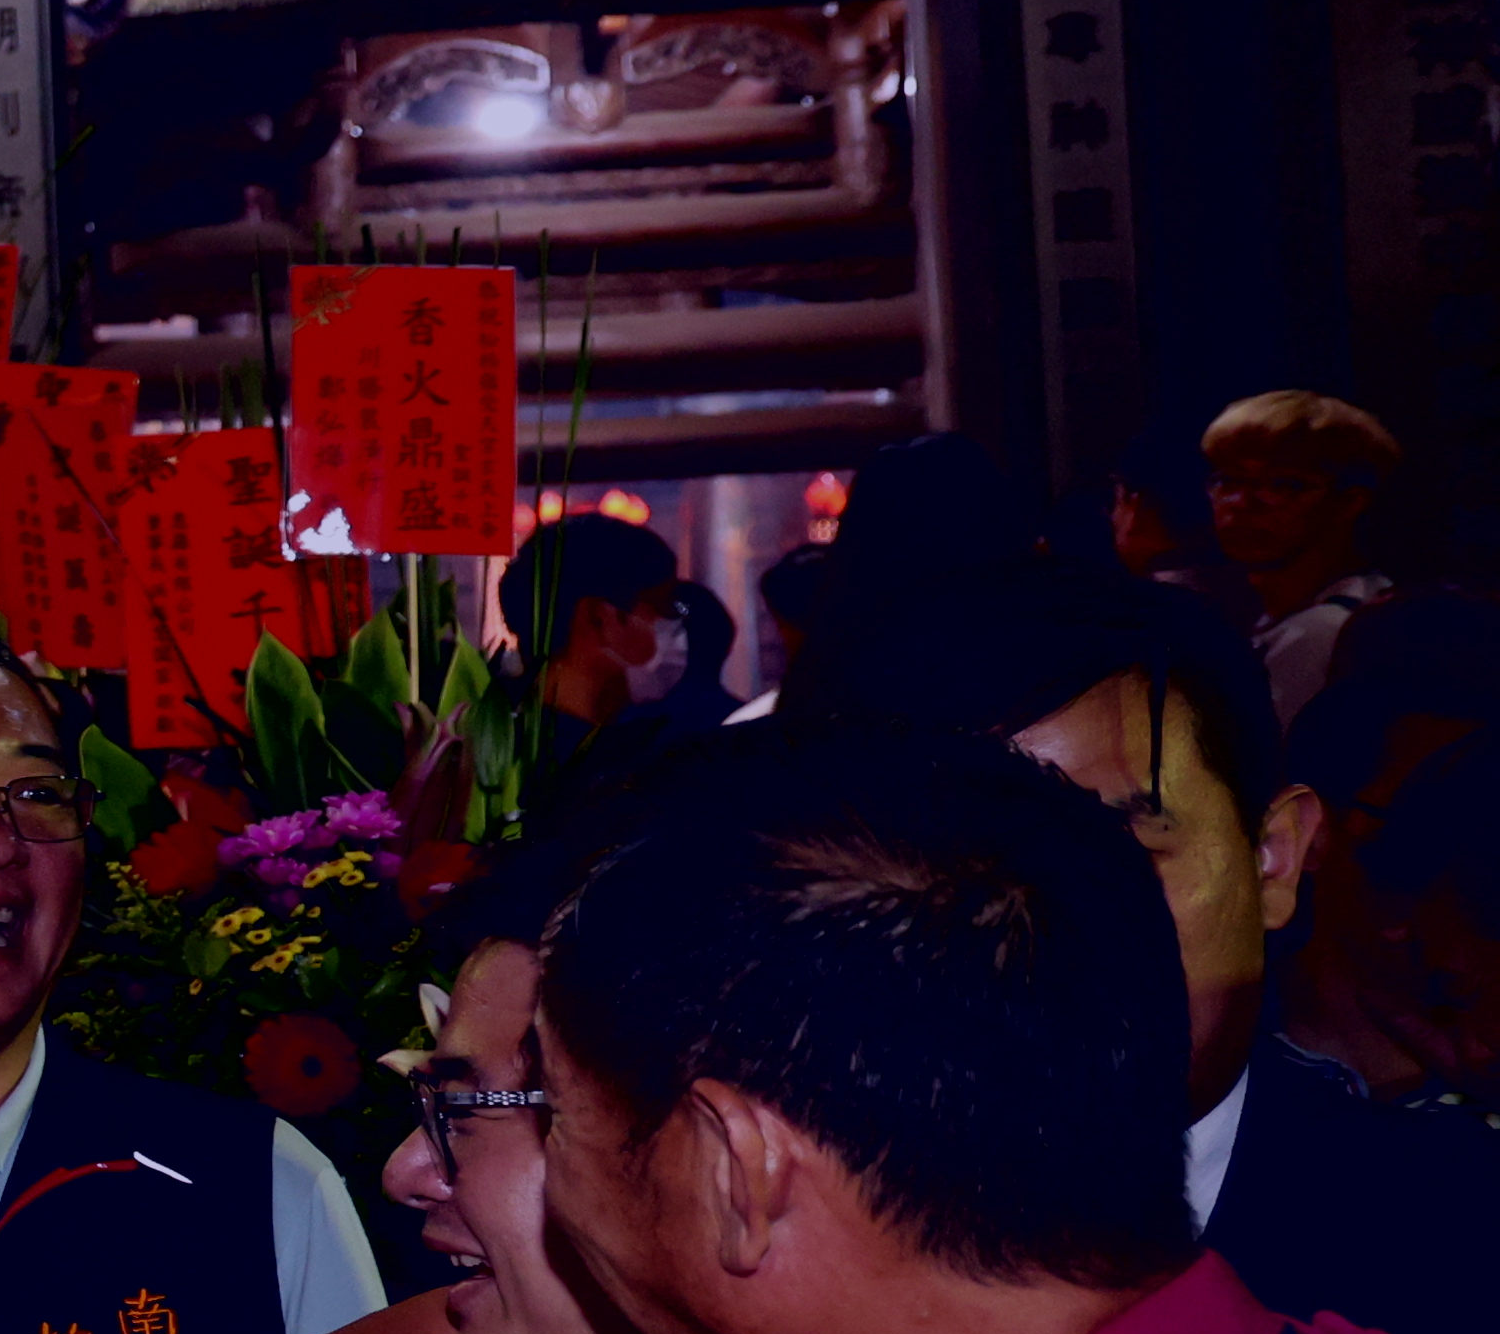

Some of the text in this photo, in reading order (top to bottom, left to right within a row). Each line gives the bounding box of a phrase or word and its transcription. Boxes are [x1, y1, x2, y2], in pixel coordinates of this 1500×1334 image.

[396, 297, 449, 533] 香火鼎盛
[222, 455, 285, 707] 聖誕千
